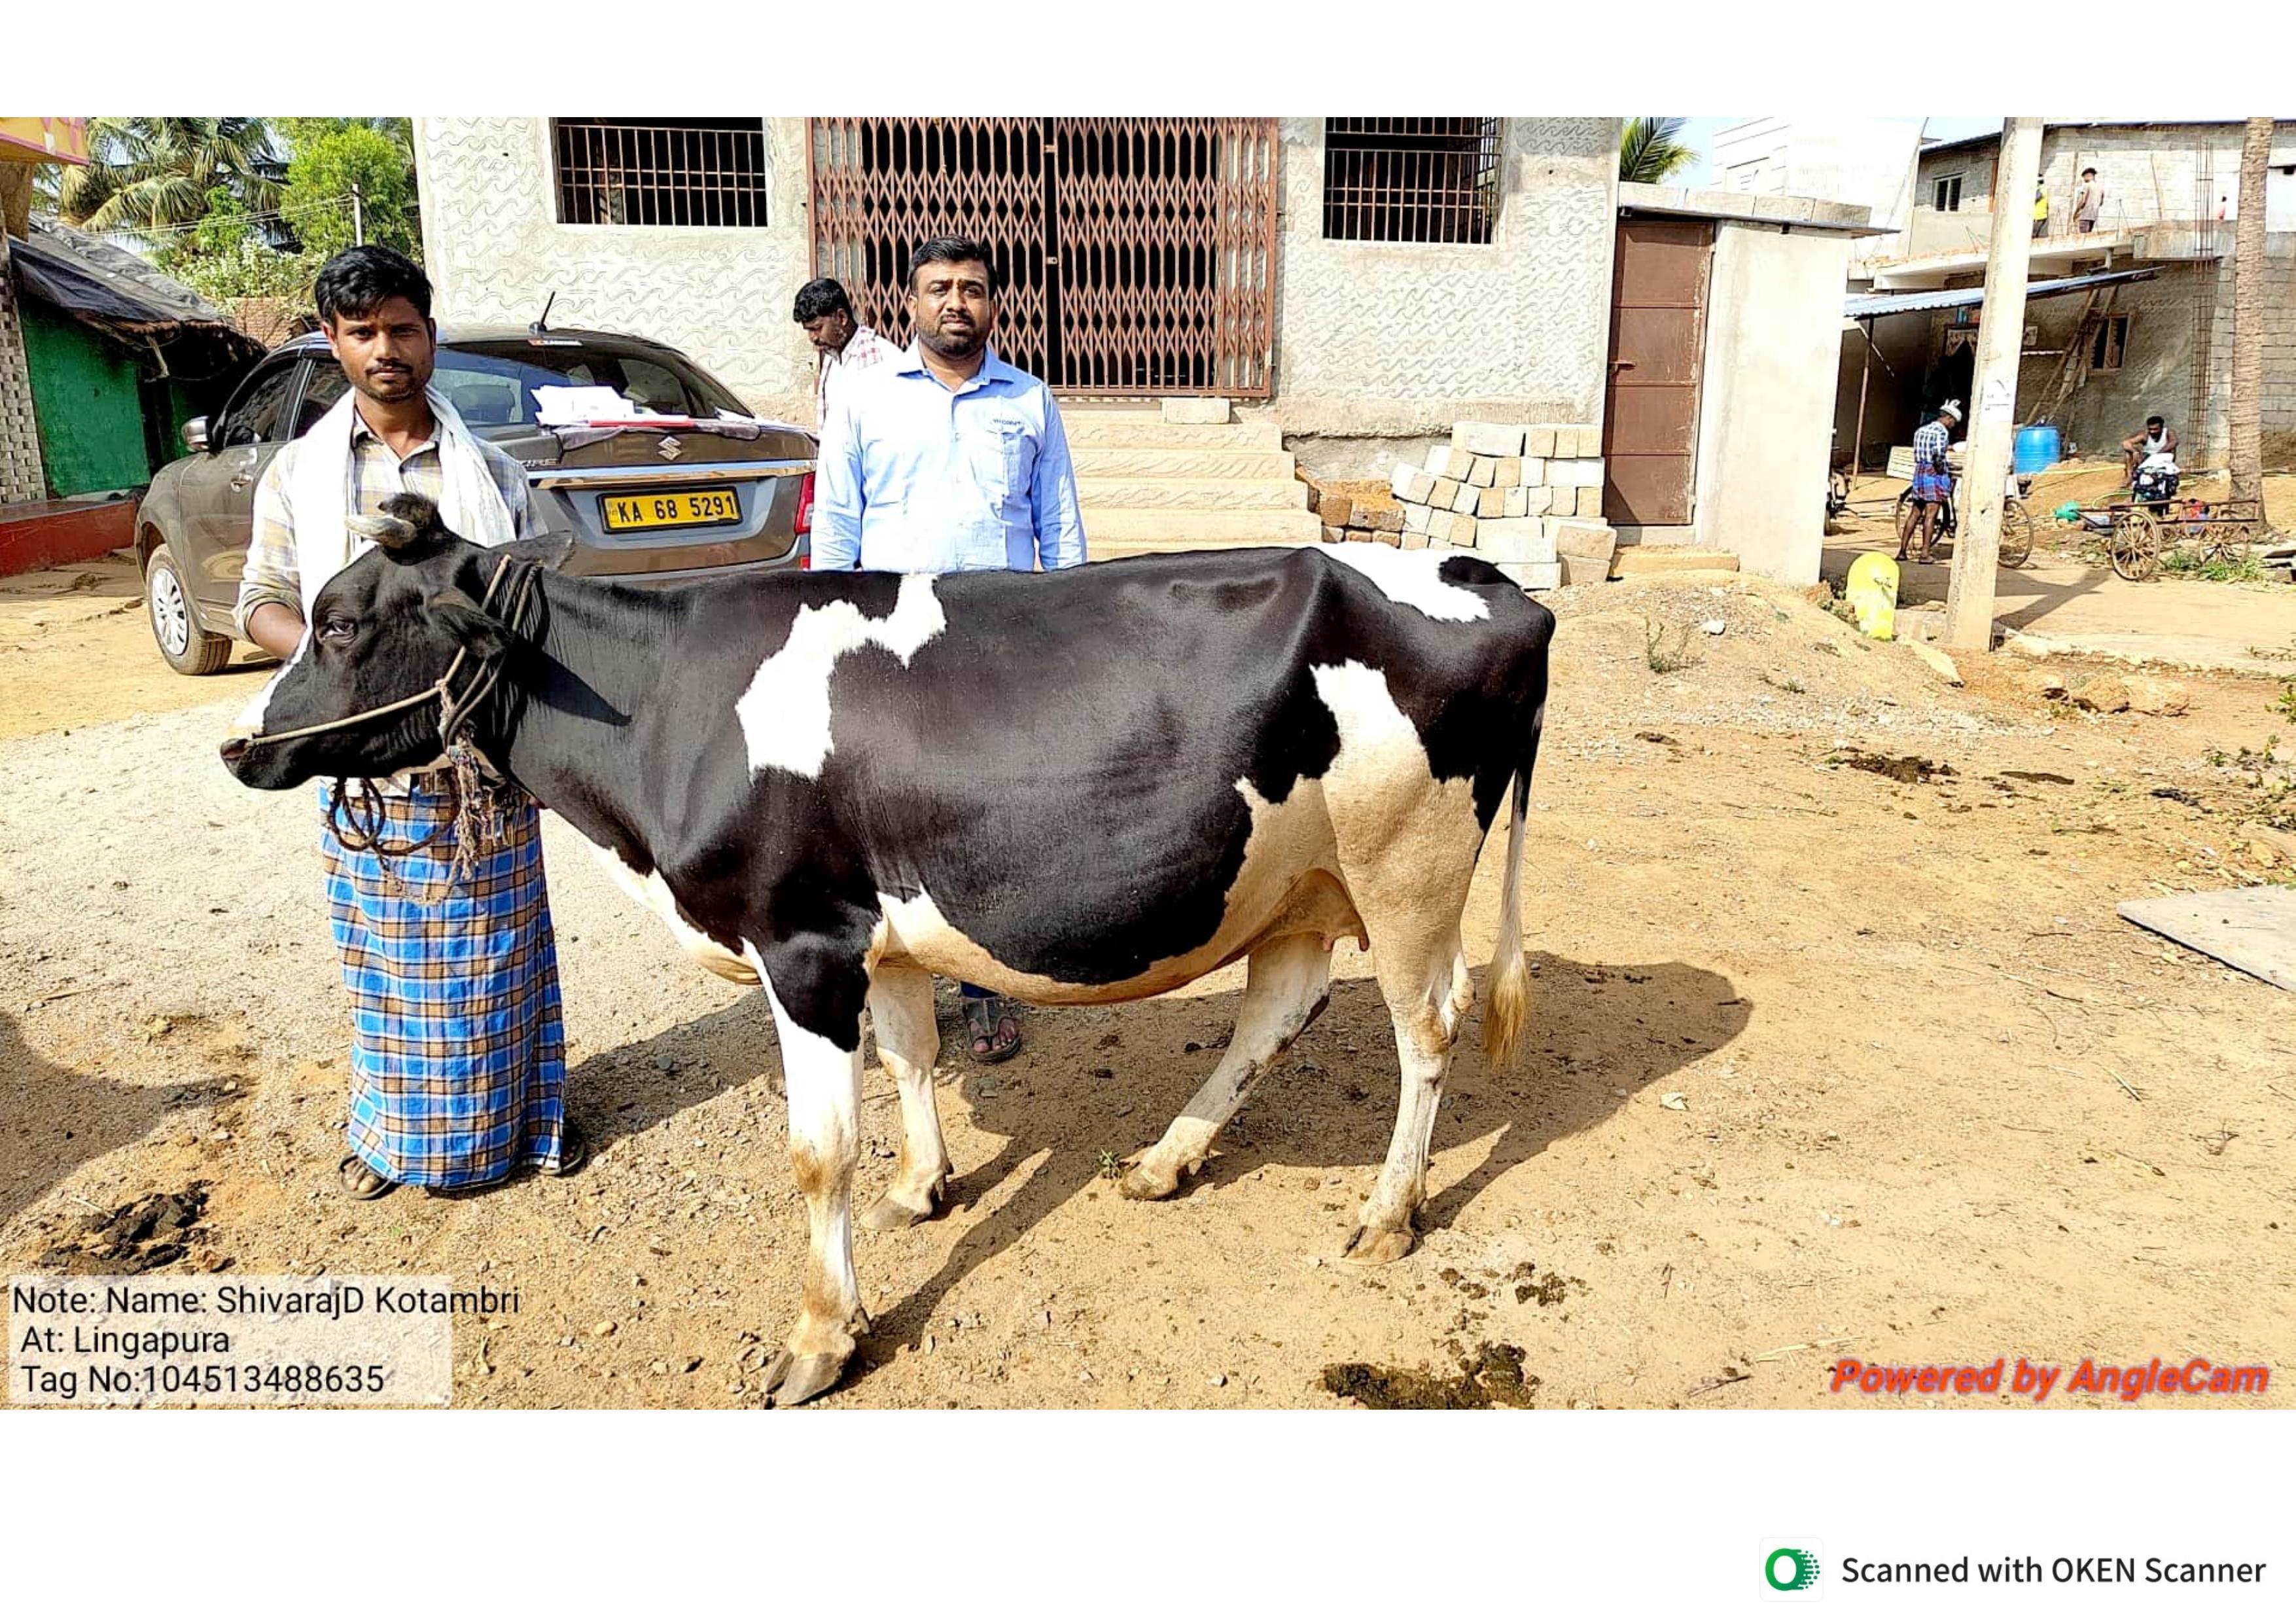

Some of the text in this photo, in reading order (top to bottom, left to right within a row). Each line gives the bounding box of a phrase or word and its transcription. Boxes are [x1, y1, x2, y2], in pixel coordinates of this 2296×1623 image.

[617, 501, 643, 523] KA
[654, 499, 677, 520] 68
[689, 495, 734, 516] 5291
